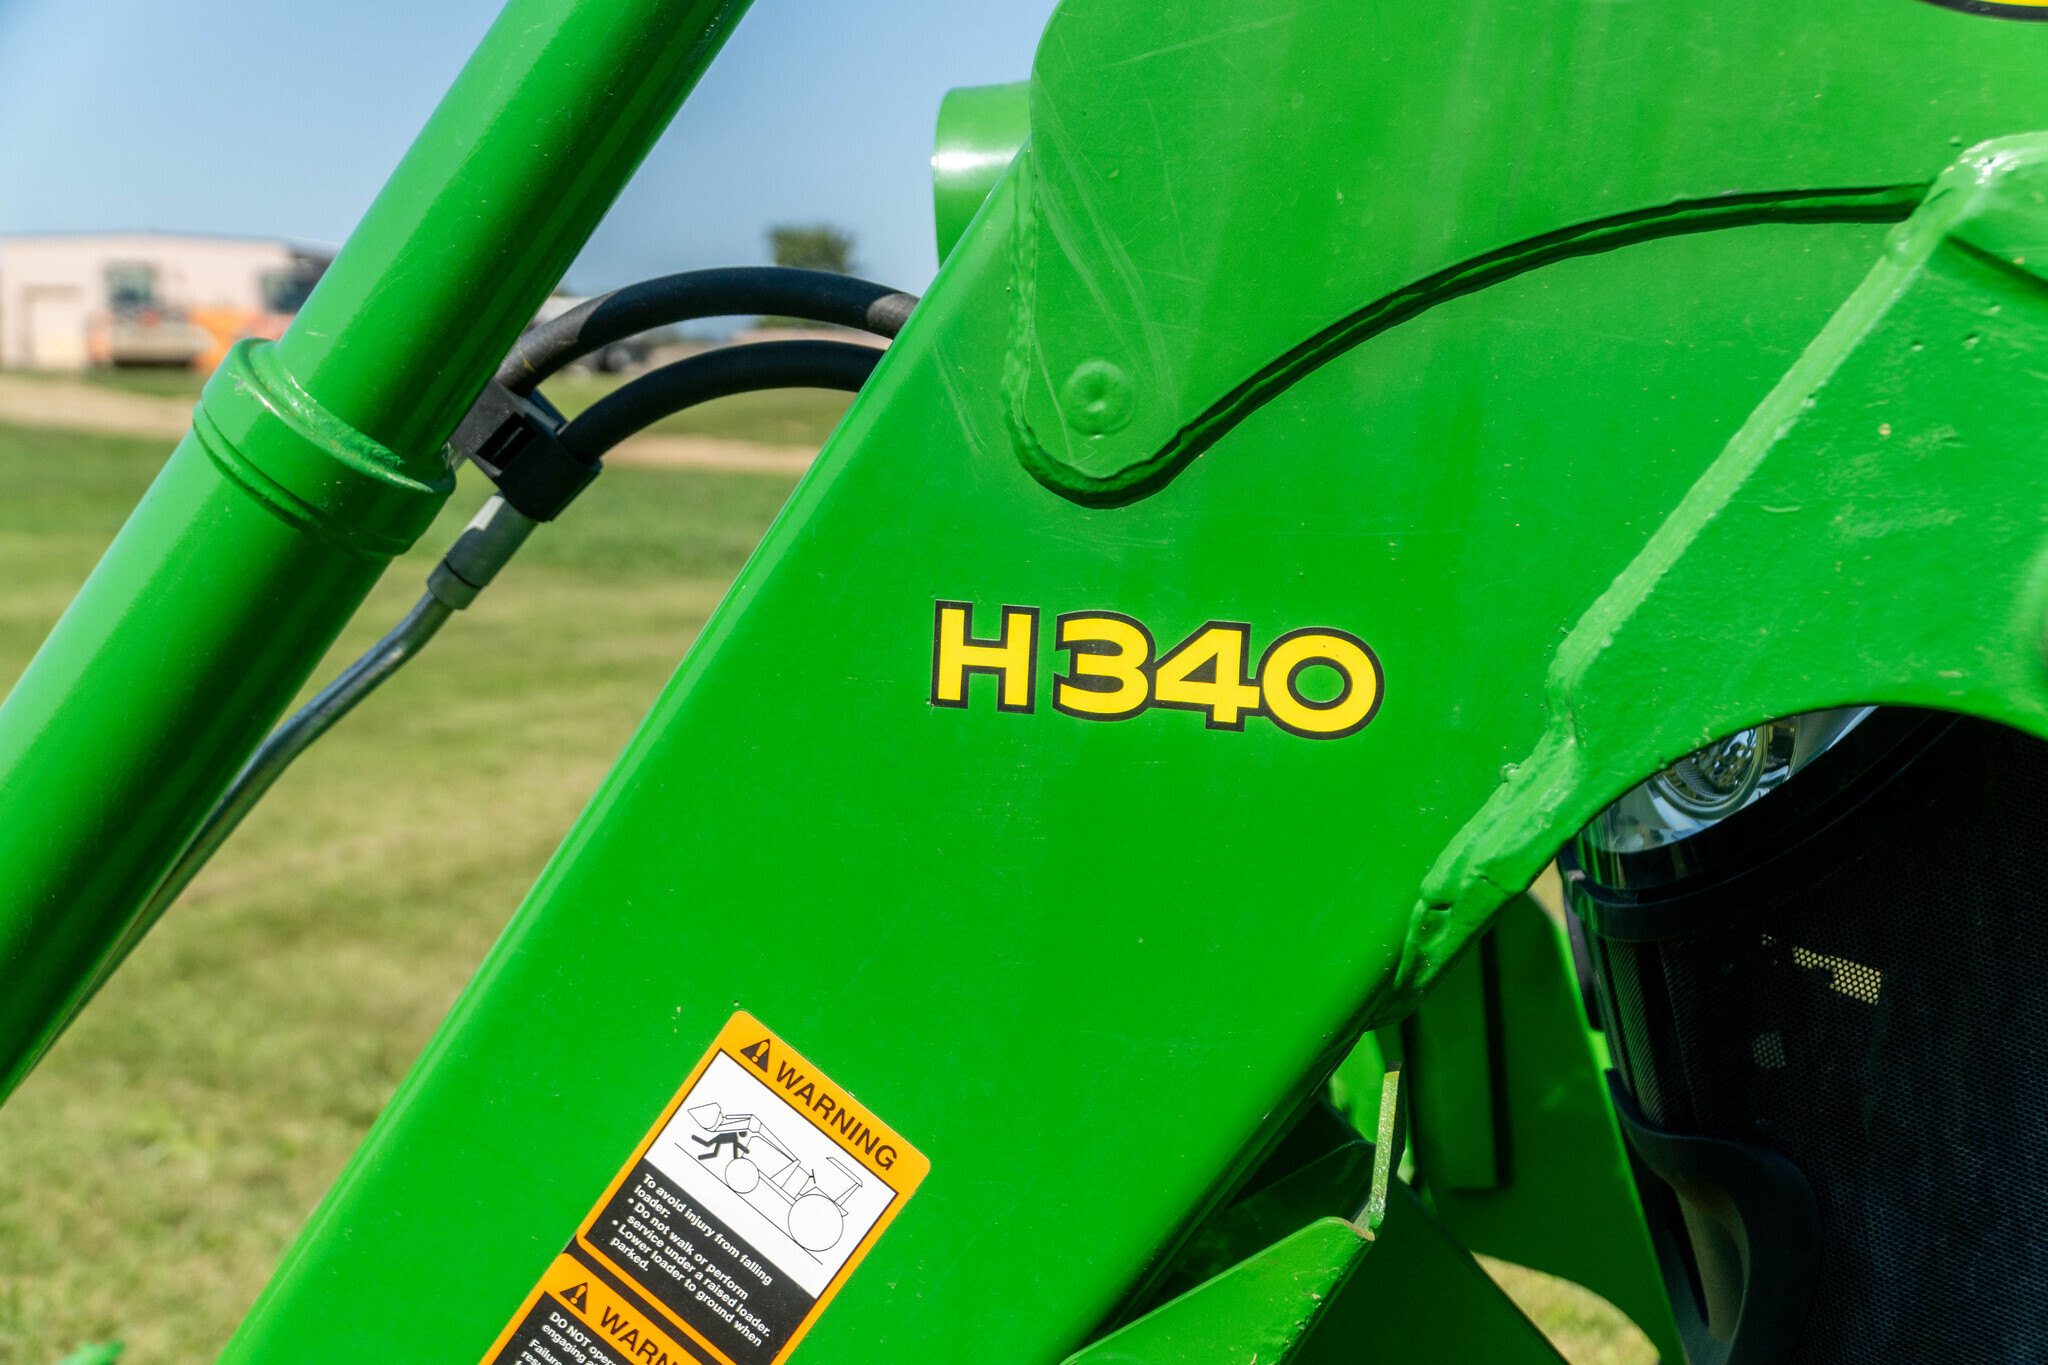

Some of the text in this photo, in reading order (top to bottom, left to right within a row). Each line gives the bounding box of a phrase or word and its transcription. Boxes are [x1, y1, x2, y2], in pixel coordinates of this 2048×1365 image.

[776, 1060, 897, 1171] WARNING
[633, 1184, 671, 1218] loader:
[643, 1173, 773, 1286] To avoid injury from falling
[609, 1237, 649, 1272] parked.
[618, 1224, 762, 1347] Lower loader to ground when
[627, 1215, 771, 1337] service under a raised loader.
[633, 1202, 749, 1300] Do not walk or perform
[541, 1324, 587, 1364] engaging
[549, 1311, 568, 1329] DO
[566, 1325, 591, 1347] NOT
